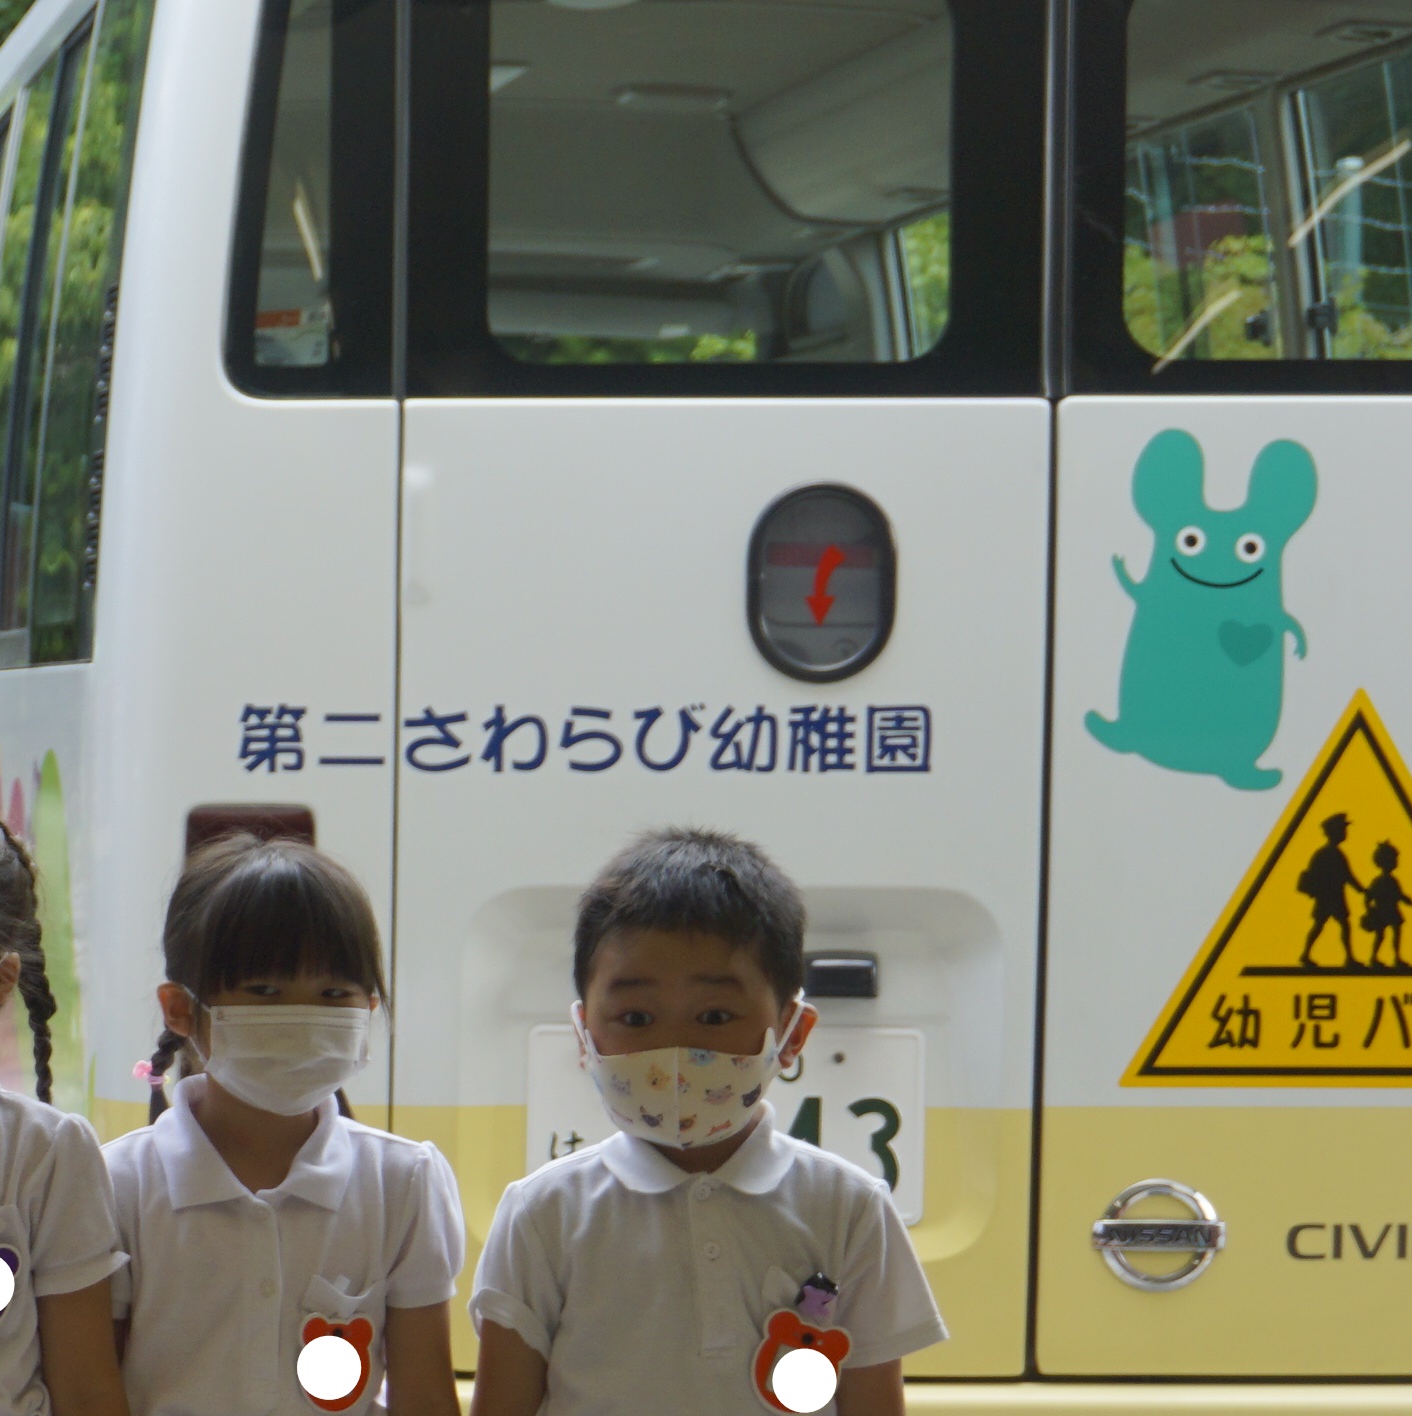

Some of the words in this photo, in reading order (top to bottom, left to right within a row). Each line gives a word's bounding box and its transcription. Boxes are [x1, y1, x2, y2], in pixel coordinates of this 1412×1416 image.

[237, 702, 932, 774] 第二さわらび幼稚園
[1107, 1226, 1213, 1250] NISSAN
